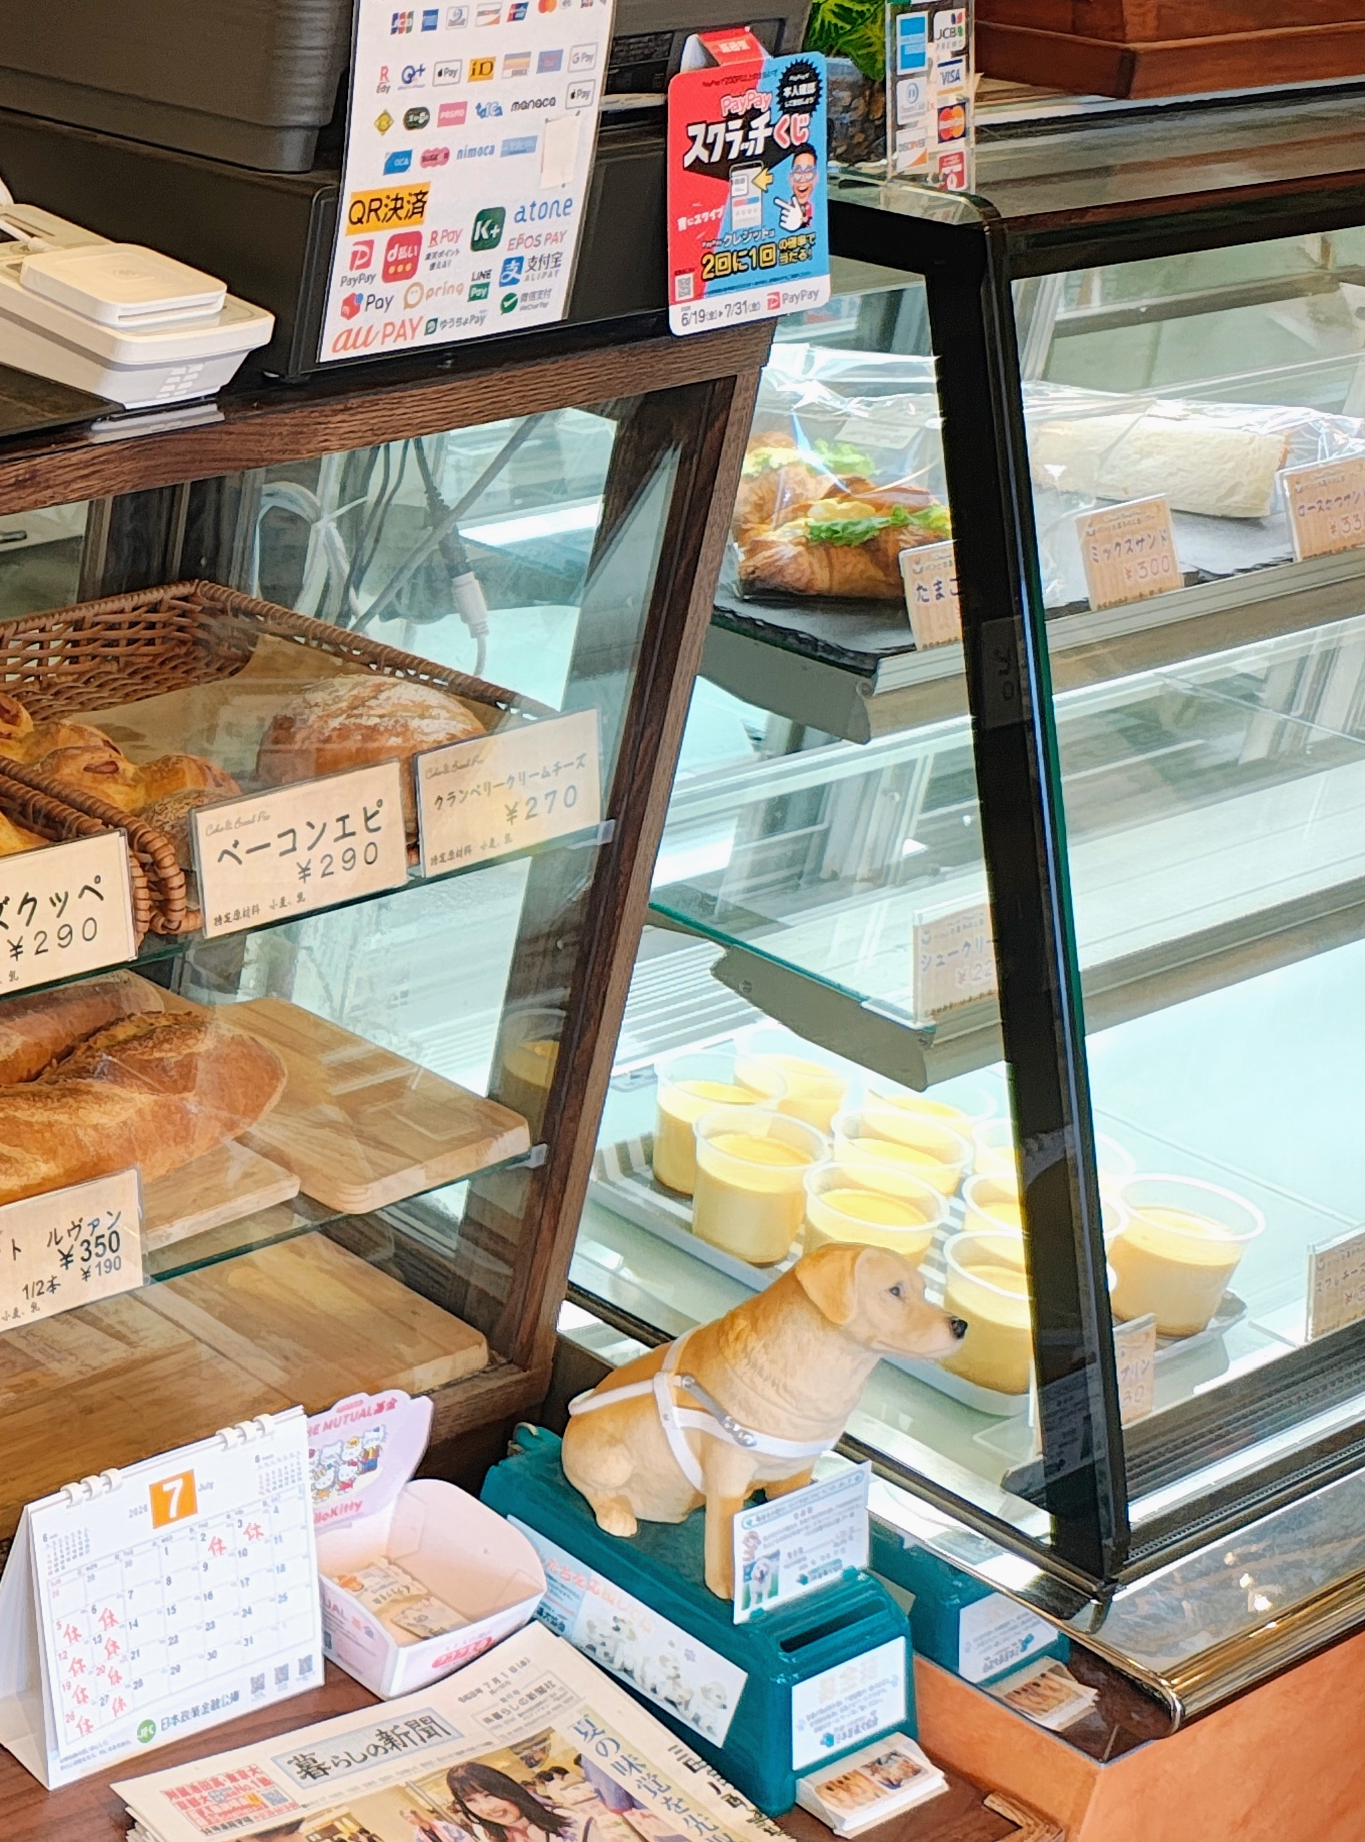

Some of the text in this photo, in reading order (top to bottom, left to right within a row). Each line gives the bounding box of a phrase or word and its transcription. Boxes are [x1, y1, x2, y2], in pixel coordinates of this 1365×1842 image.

[935, 27, 957, 41] JCB
[470, 59, 494, 78] iD
[940, 69, 962, 86] VISA
[721, 89, 773, 118] PayPay
[456, 144, 495, 160] nimoca
[683, 112, 810, 167] スクラッチくじ
[348, 190, 429, 226] QR決済
[514, 197, 573, 224] atone
[473, 219, 501, 242] K+
[507, 230, 568, 253] EPOS PAY
[701, 242, 777, 281] 2回に1回
[340, 272, 377, 288] PayPay
[471, 269, 493, 282] LINE
[524, 269, 560, 283] ALIPAY
[365, 294, 395, 313] Pay
[469, 285, 488, 298] Pay
[782, 289, 820, 305] PayPay
[332, 316, 425, 355] au PAY
[434, 753, 587, 812] クランベリークリームチーズ
[503, 784, 579, 827] ¥270
[217, 797, 384, 867] ベーコンエピ
[296, 840, 379, 884] ¥290
[7, 916, 98, 962] ¥290
[46, 1210, 122, 1249] ルヴァン
[56, 1229, 121, 1271] ¥350
[21, 1255, 123, 1302] 1/2本 ¥190
[322, 1408, 373, 1433] MUTUAL
[162, 1477, 184, 1519] 7
[200, 1532, 207, 1542] 2
[236, 1519, 243, 1528] 3
[286, 1714, 453, 1781] 暮らしの新聞
